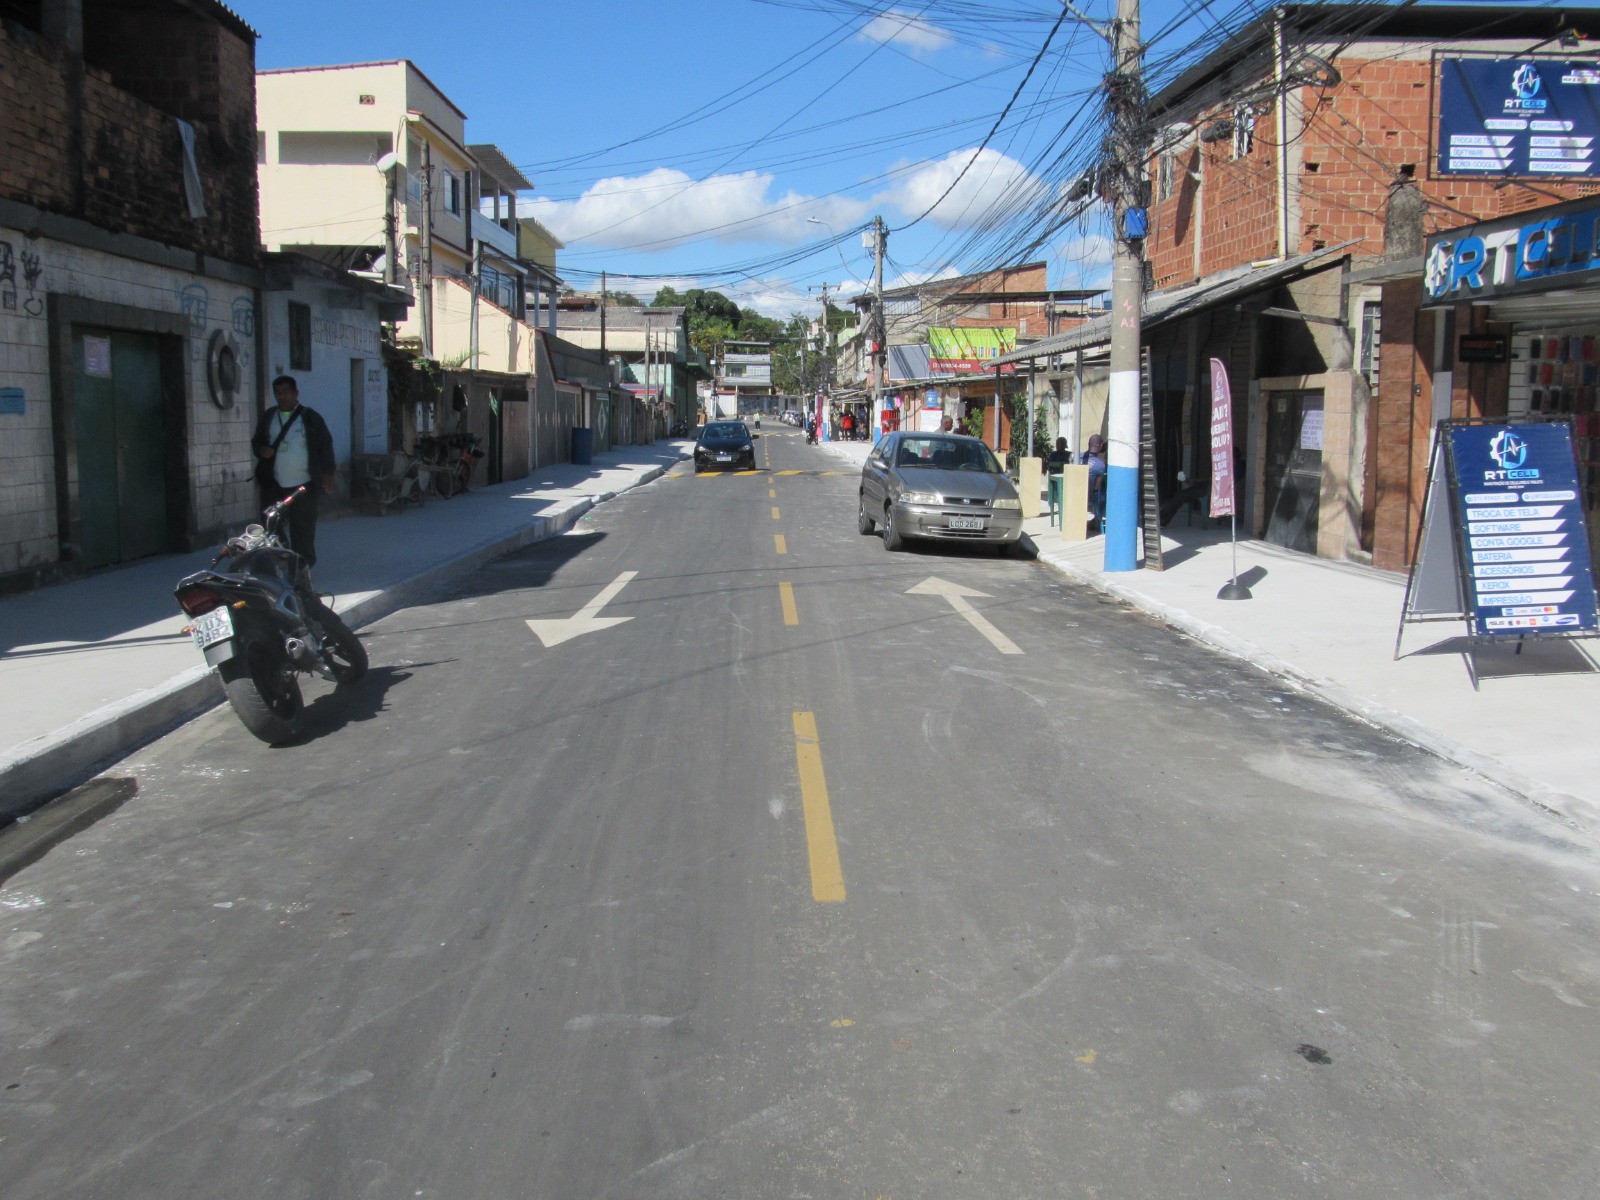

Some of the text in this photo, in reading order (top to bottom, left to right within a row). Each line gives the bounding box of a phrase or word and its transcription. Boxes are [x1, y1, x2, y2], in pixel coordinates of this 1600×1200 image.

[1504, 99, 1545, 108] RT CELL
[1450, 228, 1520, 292] RT
[1121, 317, 1135, 328] A1
[1484, 470, 1538, 481] RT CELL
[1472, 508, 1540, 518] TROCA DE TELA
[1474, 523, 1522, 533] SOFTWARE
[1475, 537, 1544, 547] CONTA GOOGLE
[1477, 552, 1512, 561] BATERIA
[1481, 581, 1510, 590] XEROX
[1482, 593, 1533, 605] IMPRESSÃO
